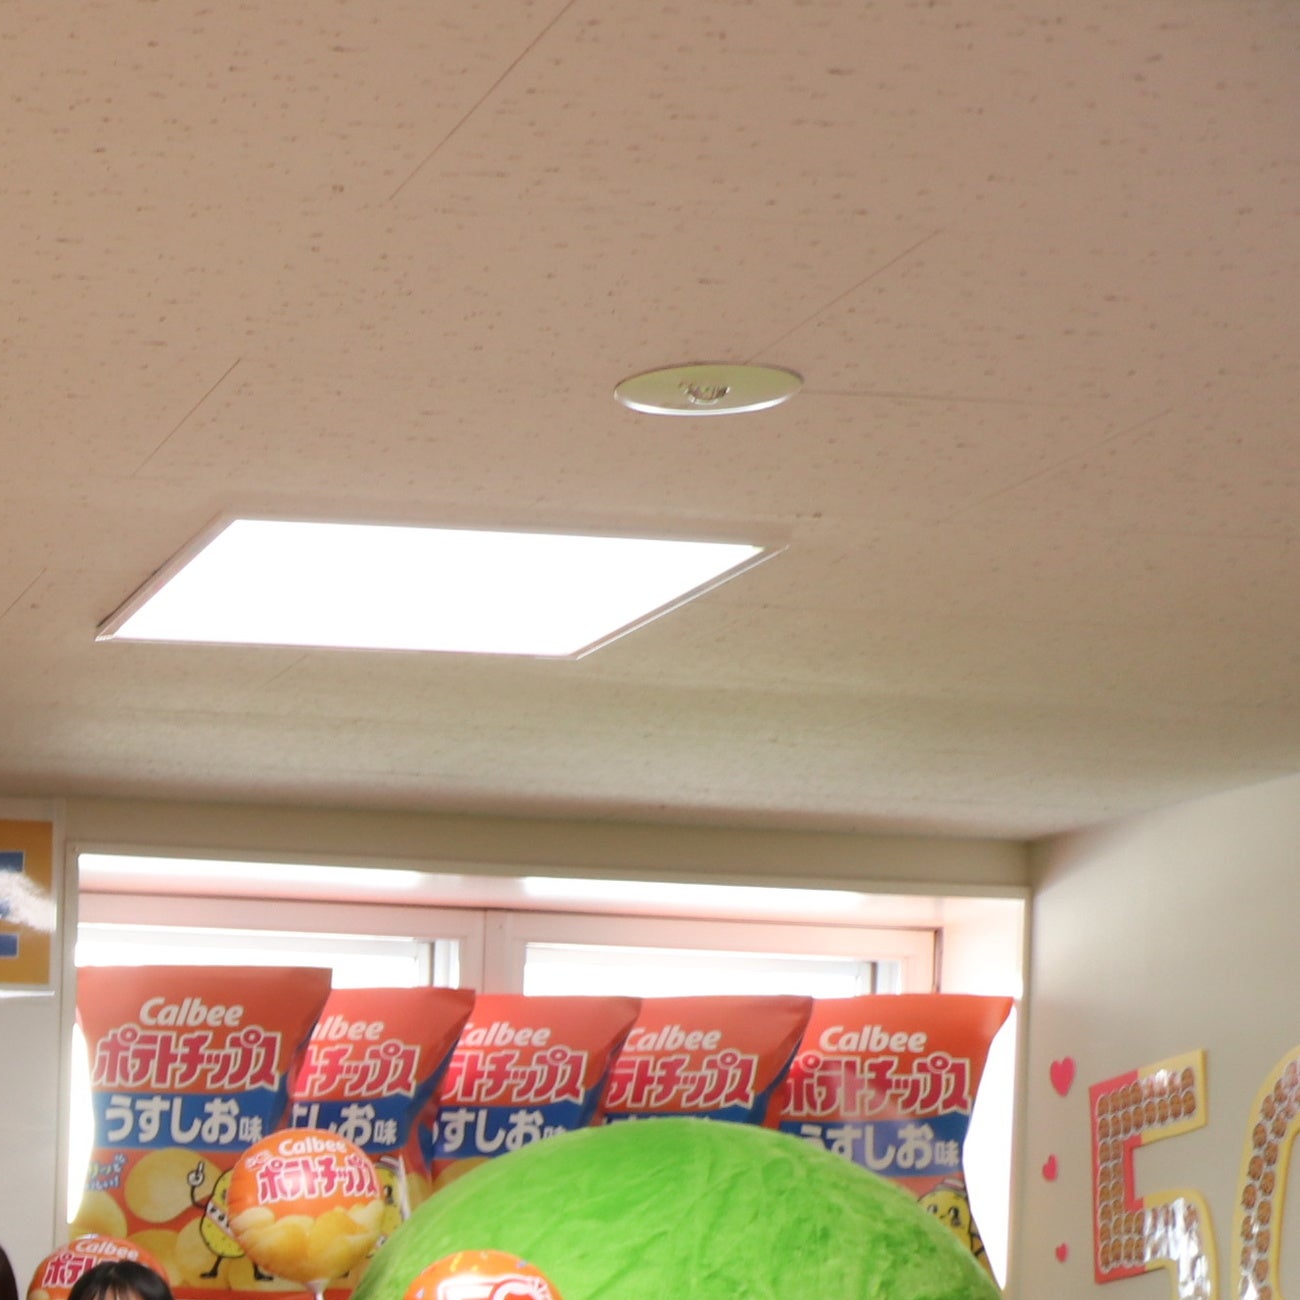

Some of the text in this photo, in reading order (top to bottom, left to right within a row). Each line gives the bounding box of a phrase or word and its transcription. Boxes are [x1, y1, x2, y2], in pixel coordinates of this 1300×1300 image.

[139, 997, 244, 1027] Calbee
[310, 1012, 384, 1042] albee
[91, 1024, 284, 1091] ポテトチップス
[818, 1024, 928, 1054] Calbee
[440, 1043, 588, 1105] テトチップス
[607, 1047, 759, 1112] テトチップス
[780, 1048, 974, 1118] ポテトチップス
[103, 1093, 264, 1145] うすしお味
[278, 1138, 347, 1157] Calbee
[257, 1156, 378, 1205] ポテトチップス
[74, 1238, 139, 1259] Calbee
